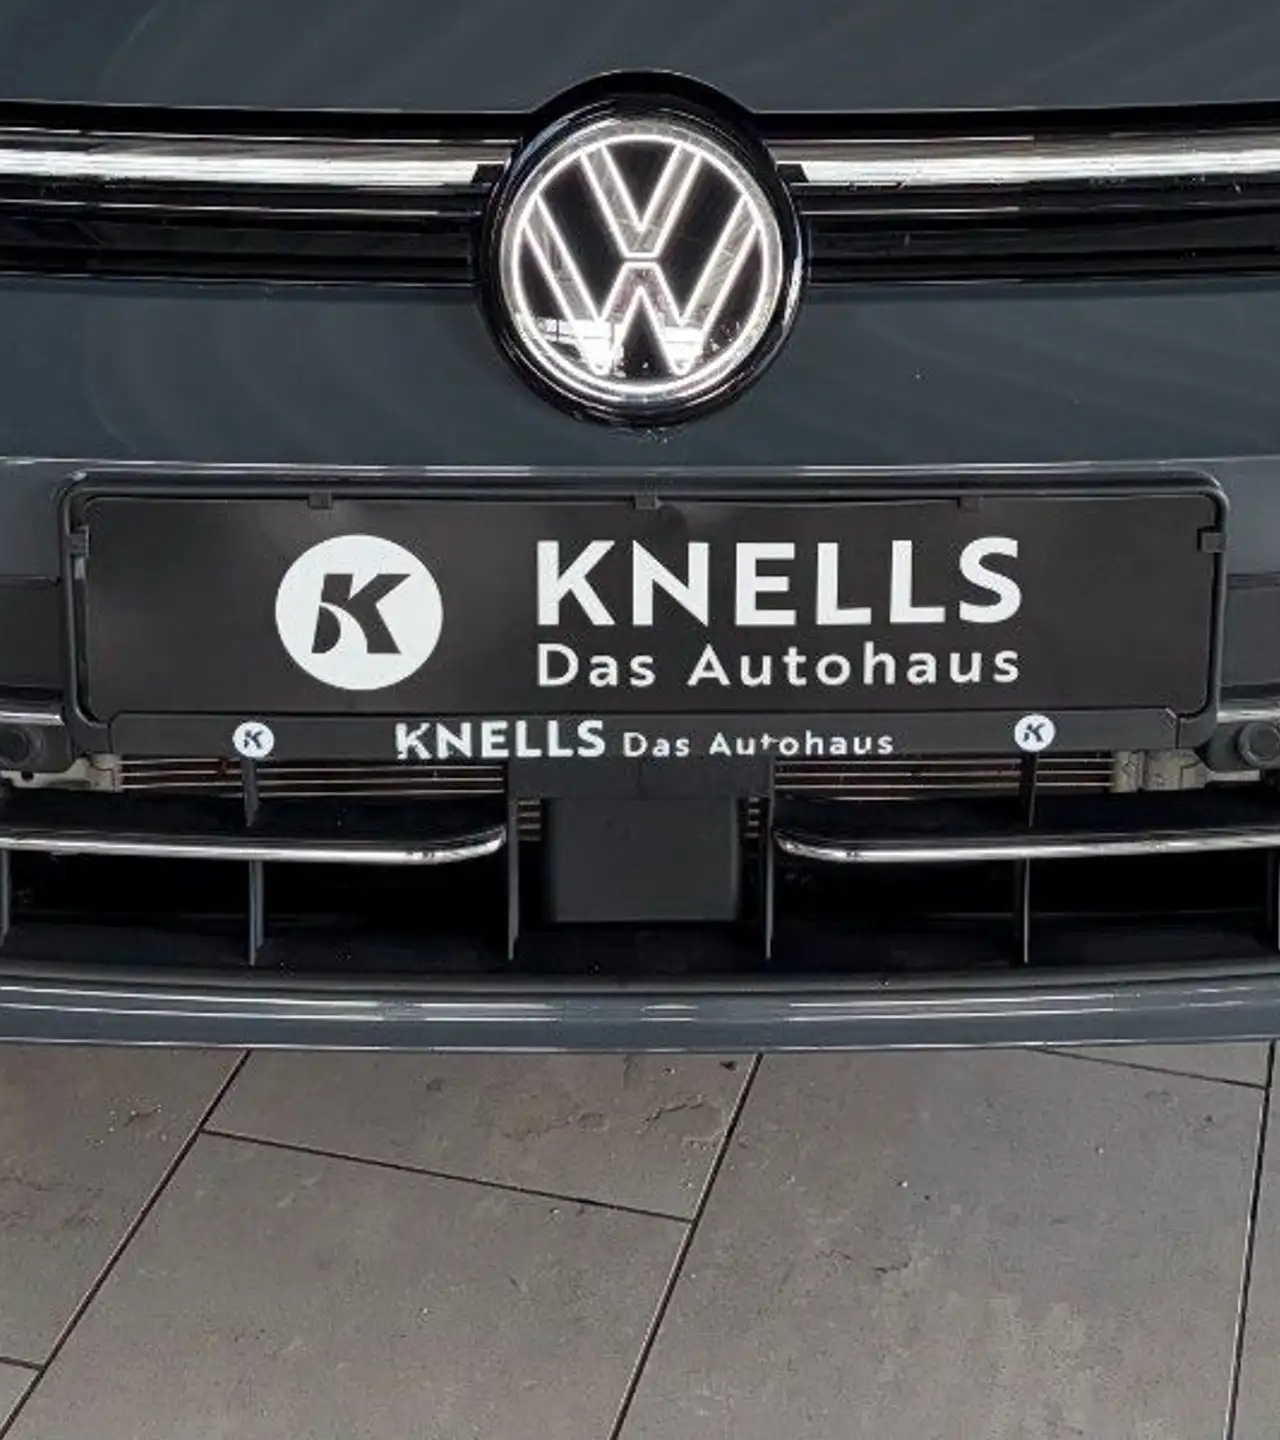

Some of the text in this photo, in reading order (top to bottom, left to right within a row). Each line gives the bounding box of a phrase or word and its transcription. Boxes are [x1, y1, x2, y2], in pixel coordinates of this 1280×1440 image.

[519, 143, 763, 376] VW
[537, 536, 1023, 627] KNELLS
[538, 641, 1019, 687] Das Autohaus
[394, 719, 895, 760] KNELLS Das Autohaus
